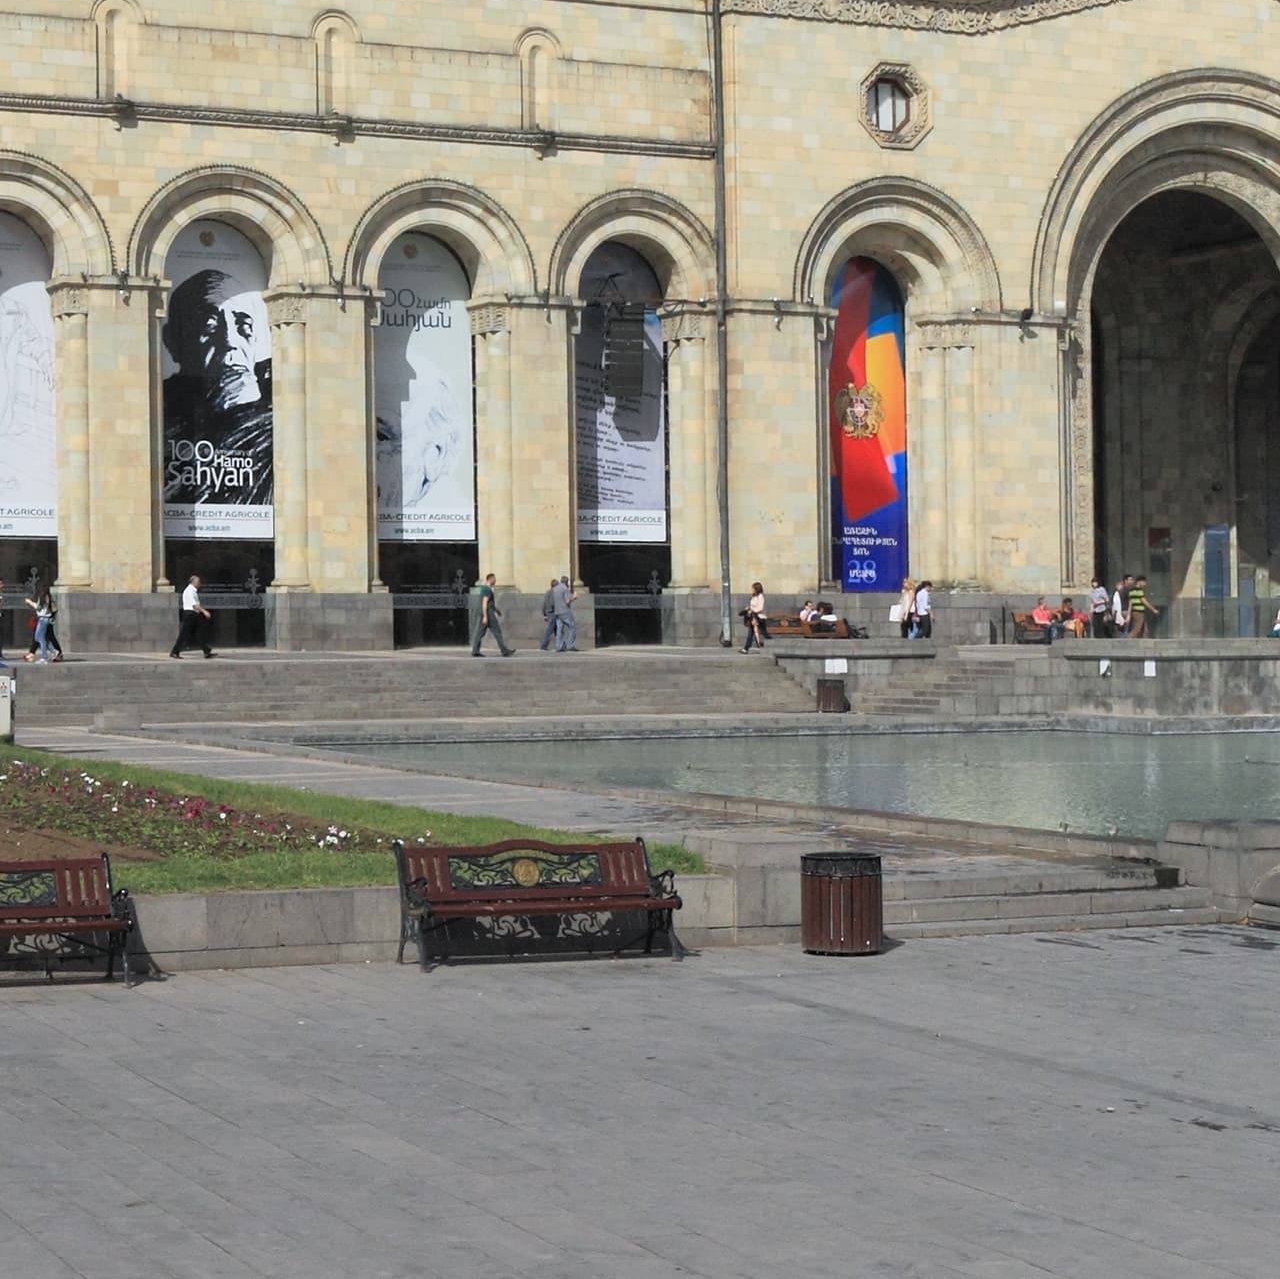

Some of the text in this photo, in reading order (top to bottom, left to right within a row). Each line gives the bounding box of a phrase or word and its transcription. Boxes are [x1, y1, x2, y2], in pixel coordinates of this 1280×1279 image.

[168, 439, 215, 462] 100
[213, 454, 254, 468] Hamo
[167, 460, 254, 493] Sahyan
[6, 508, 55, 517] AGRICOLE
[224, 511, 271, 519] AGRICOLE
[428, 514, 472, 522] AGRICOLE
